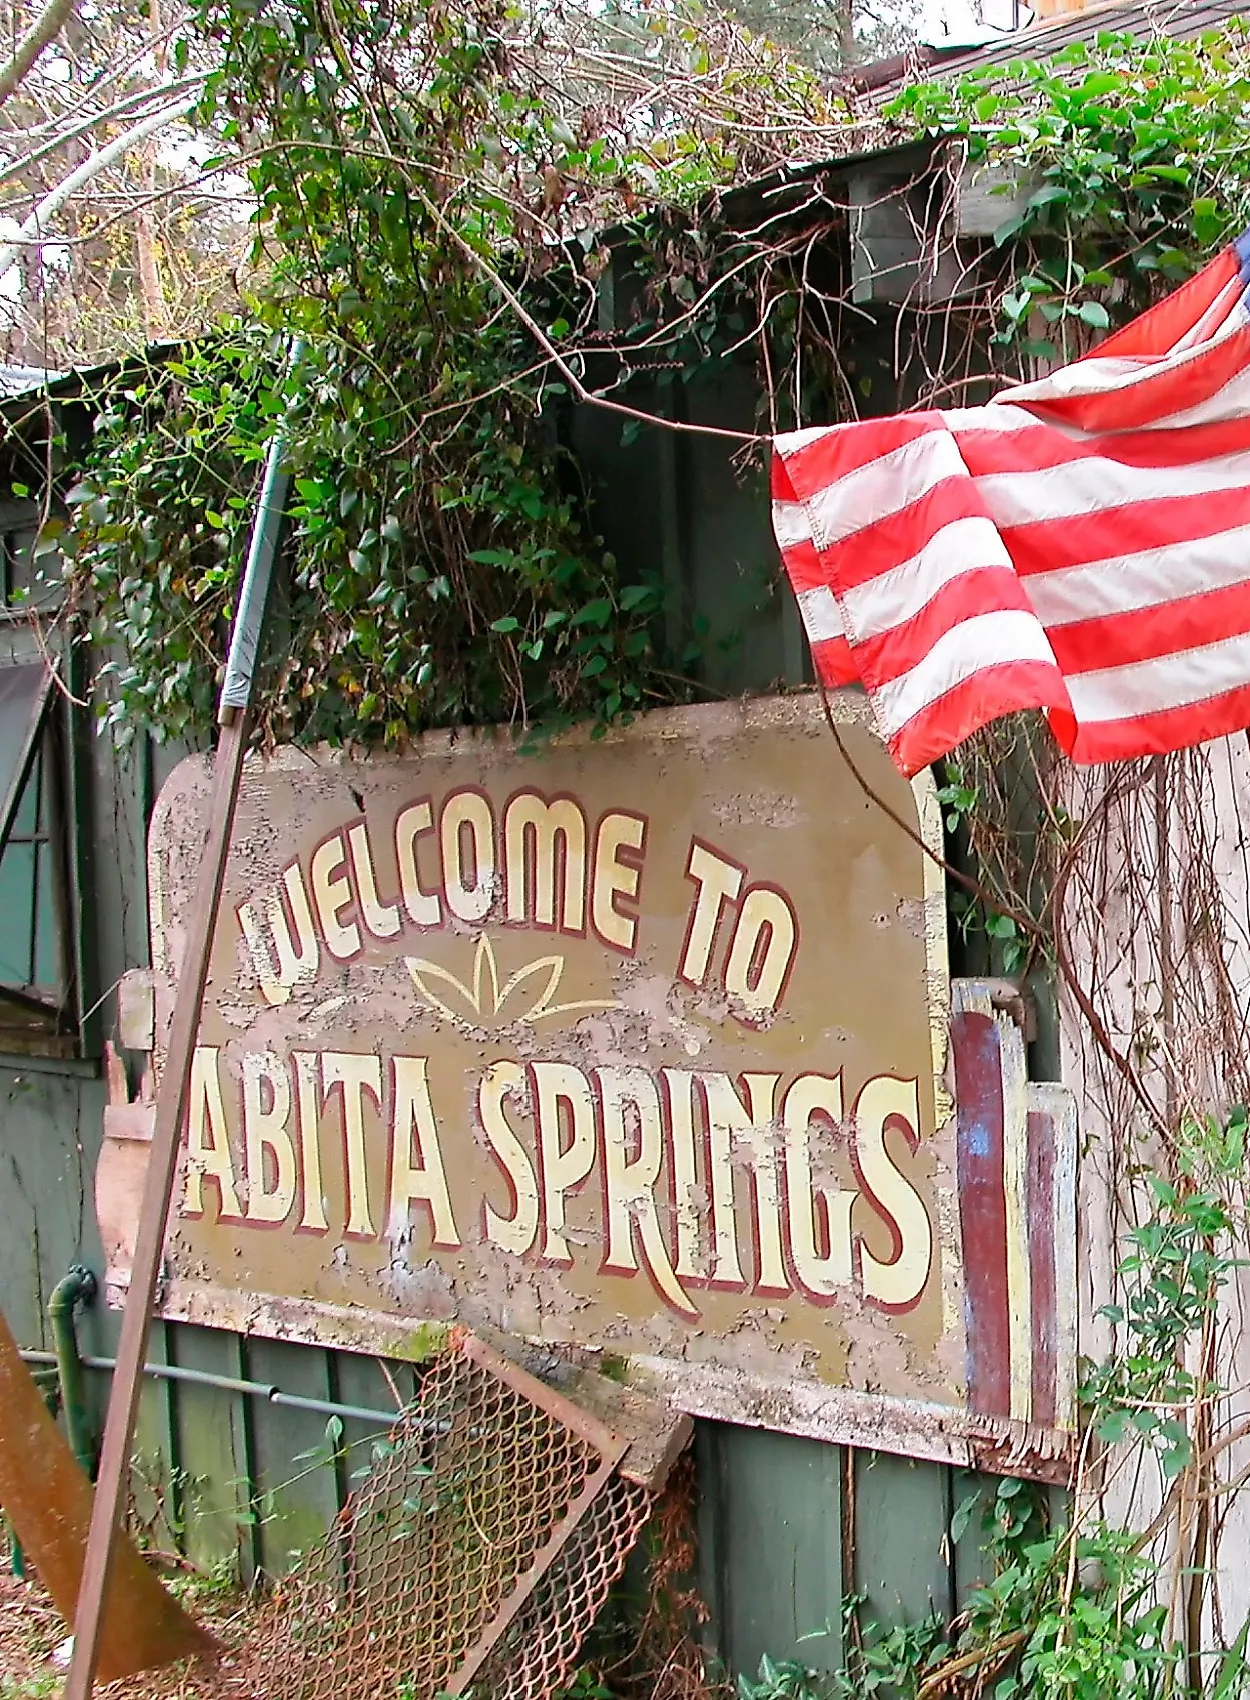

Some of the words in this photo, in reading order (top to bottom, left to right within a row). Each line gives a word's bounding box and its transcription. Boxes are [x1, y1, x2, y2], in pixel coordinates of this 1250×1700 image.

[235, 783, 650, 1008] WELCOME
[676, 834, 799, 1030] TO
[180, 1043, 463, 1252] ABITA
[479, 1059, 934, 1323] SPRINGS
